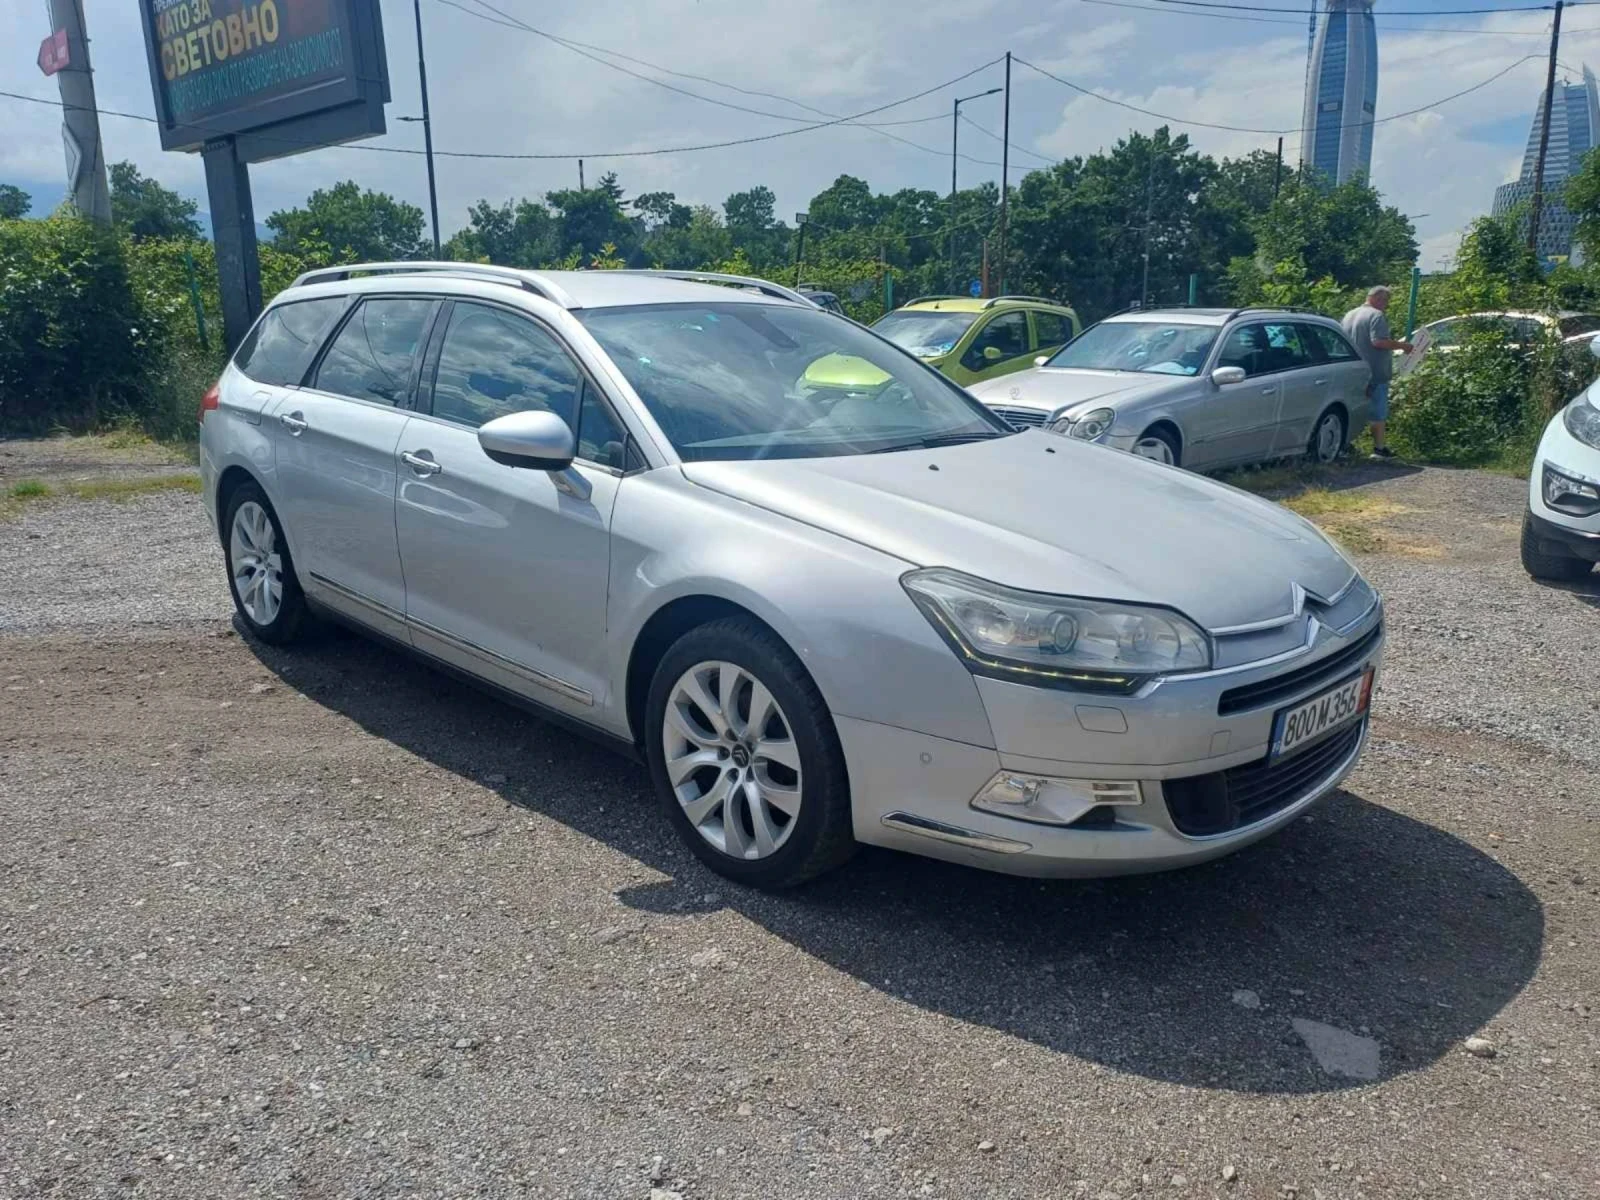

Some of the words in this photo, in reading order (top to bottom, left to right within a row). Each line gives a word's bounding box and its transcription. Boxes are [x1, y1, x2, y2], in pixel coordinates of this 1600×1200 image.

[157, 4, 189, 38] КАТО
[191, 0, 212, 24] ЗА
[161, 0, 279, 80] СВЕТОВНО
